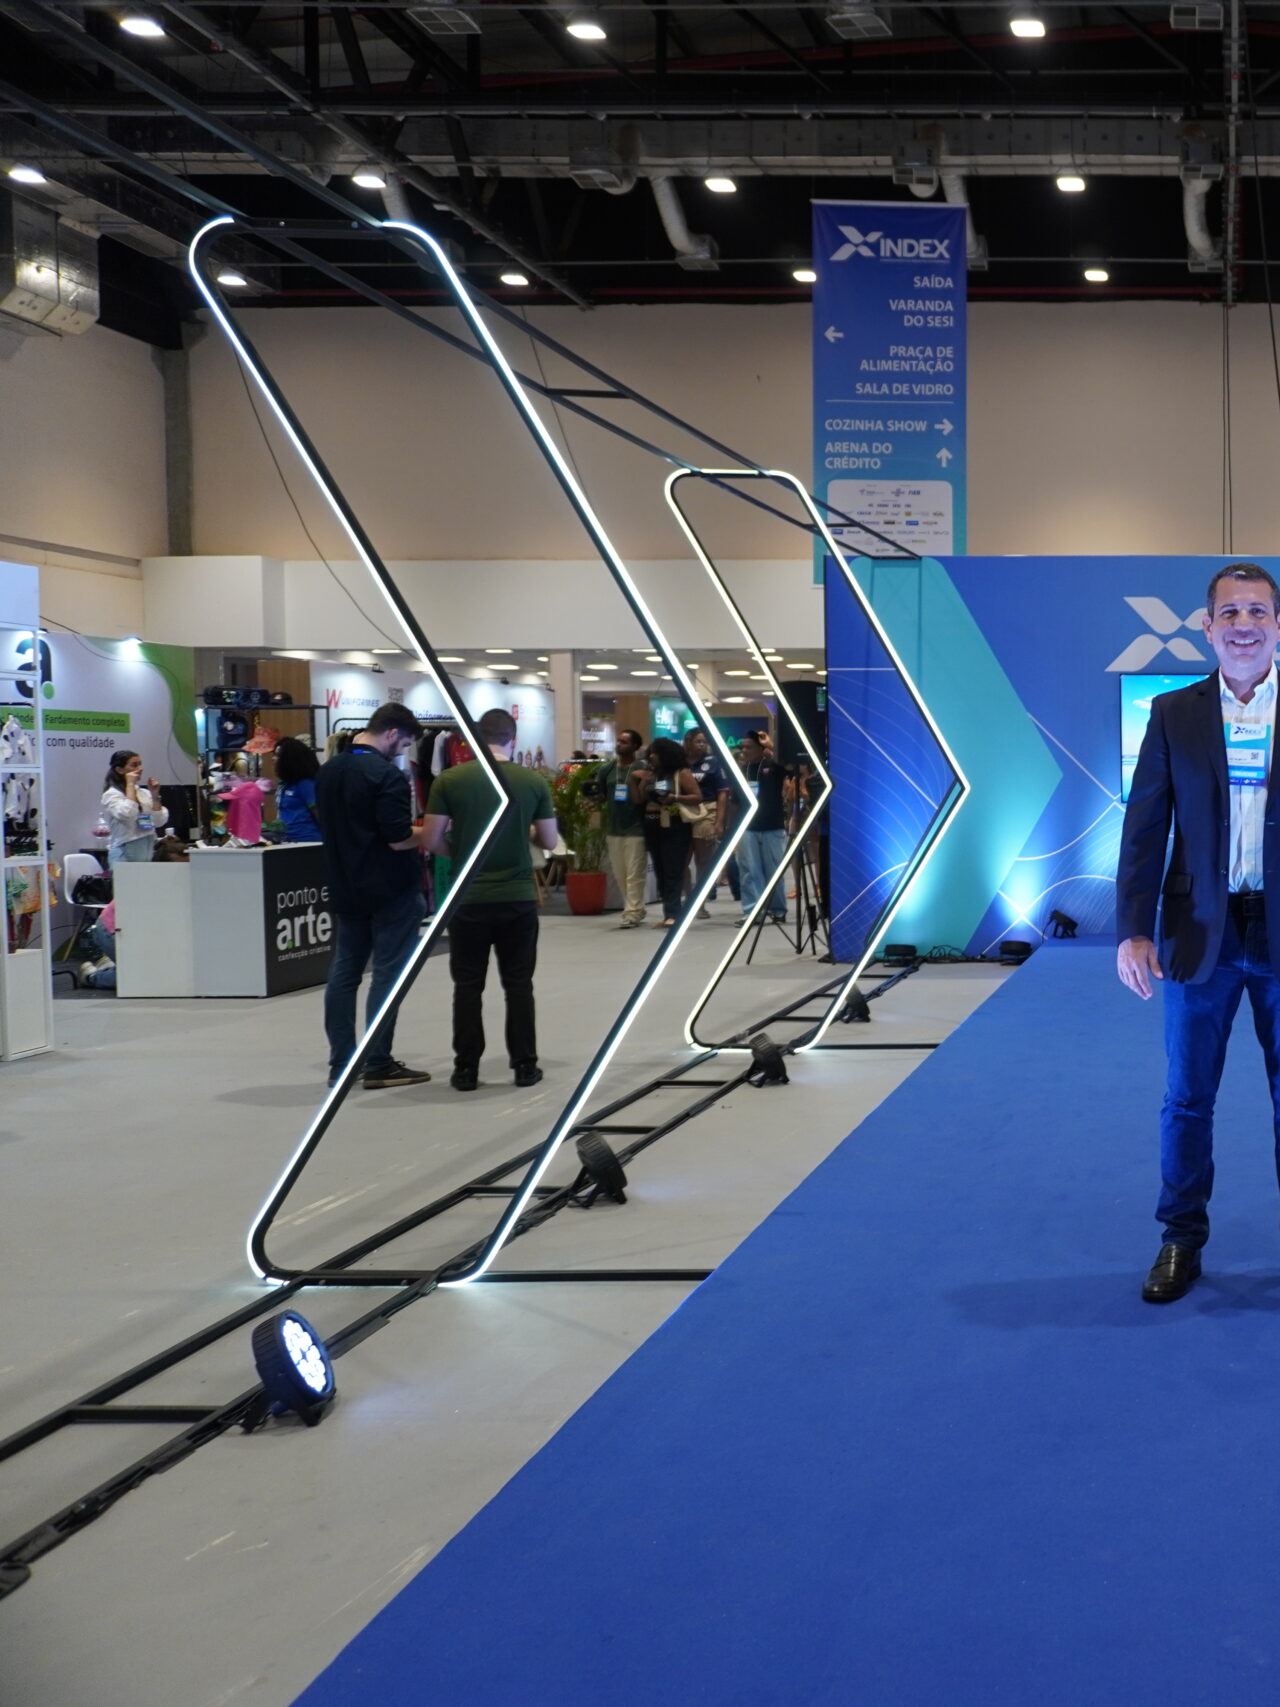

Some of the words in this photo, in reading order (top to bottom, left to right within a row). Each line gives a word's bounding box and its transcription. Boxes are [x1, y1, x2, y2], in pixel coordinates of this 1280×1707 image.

[880, 238, 950, 259] INDEX
[913, 274, 953, 288] SAÍDA
[889, 299, 953, 311] VARANDA
[904, 315, 924, 327] DO
[927, 315, 953, 327] SESI
[890, 346, 933, 360] PRAÇA
[937, 346, 953, 357] DE
[860, 359, 954, 374] ALIMENTAÇÃO
[856, 383, 889, 395] SALA
[892, 383, 910, 395] DE
[913, 384, 954, 396] VIDRO
[825, 419, 884, 431] COZINHA
[886, 420, 927, 432] SHOW
[825, 442, 868, 454] ARENA
[872, 443, 892, 454] DO
[825, 456, 881, 470] CRÉDITO
[45, 714, 91, 726] Fardamento
[92, 717, 126, 728] completo
[46, 737, 67, 747] com
[69, 736, 115, 749] qualidade
[277, 887, 318, 914] ponto
[276, 904, 332, 951] arte
